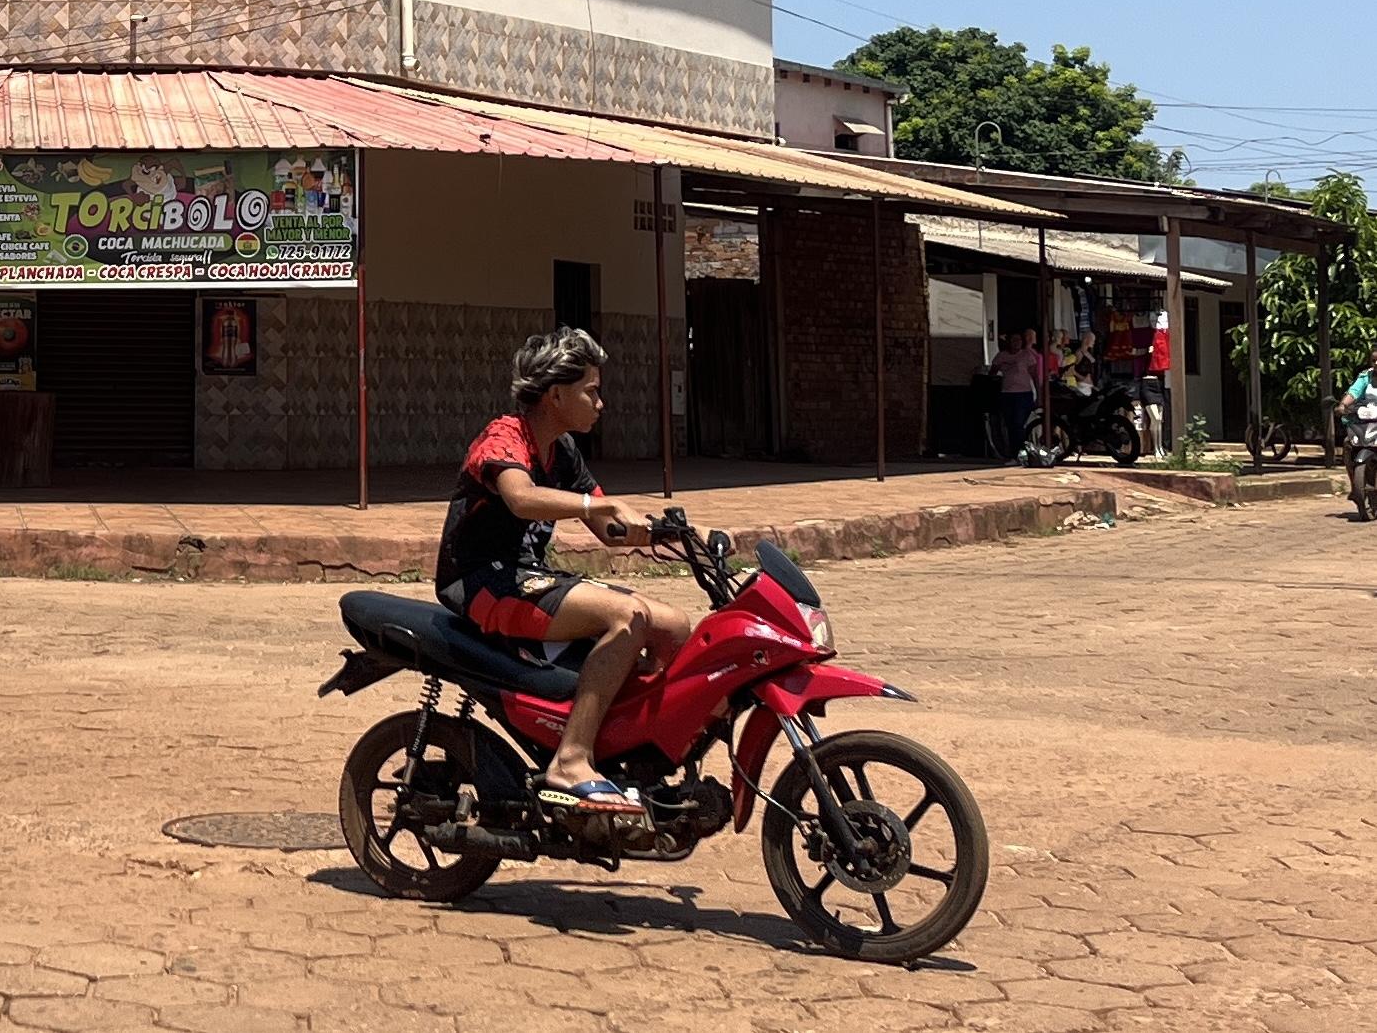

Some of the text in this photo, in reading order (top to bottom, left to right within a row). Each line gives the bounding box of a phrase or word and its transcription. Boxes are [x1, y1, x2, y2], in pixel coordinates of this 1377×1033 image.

[272, 215, 343, 228] VENTA AL POR
[266, 227, 350, 241] MAYOR Y MENOR
[98, 236, 225, 250] COCA MACHUCADA
[120, 250, 162, 264] Torcida
[279, 244, 352, 259] 725-91772
[99, 265, 135, 278] COCA
[137, 265, 191, 278] CRESPA
[209, 264, 246, 278] COCA
[248, 264, 288, 278] HOJA
[290, 263, 352, 277] GRANDE
